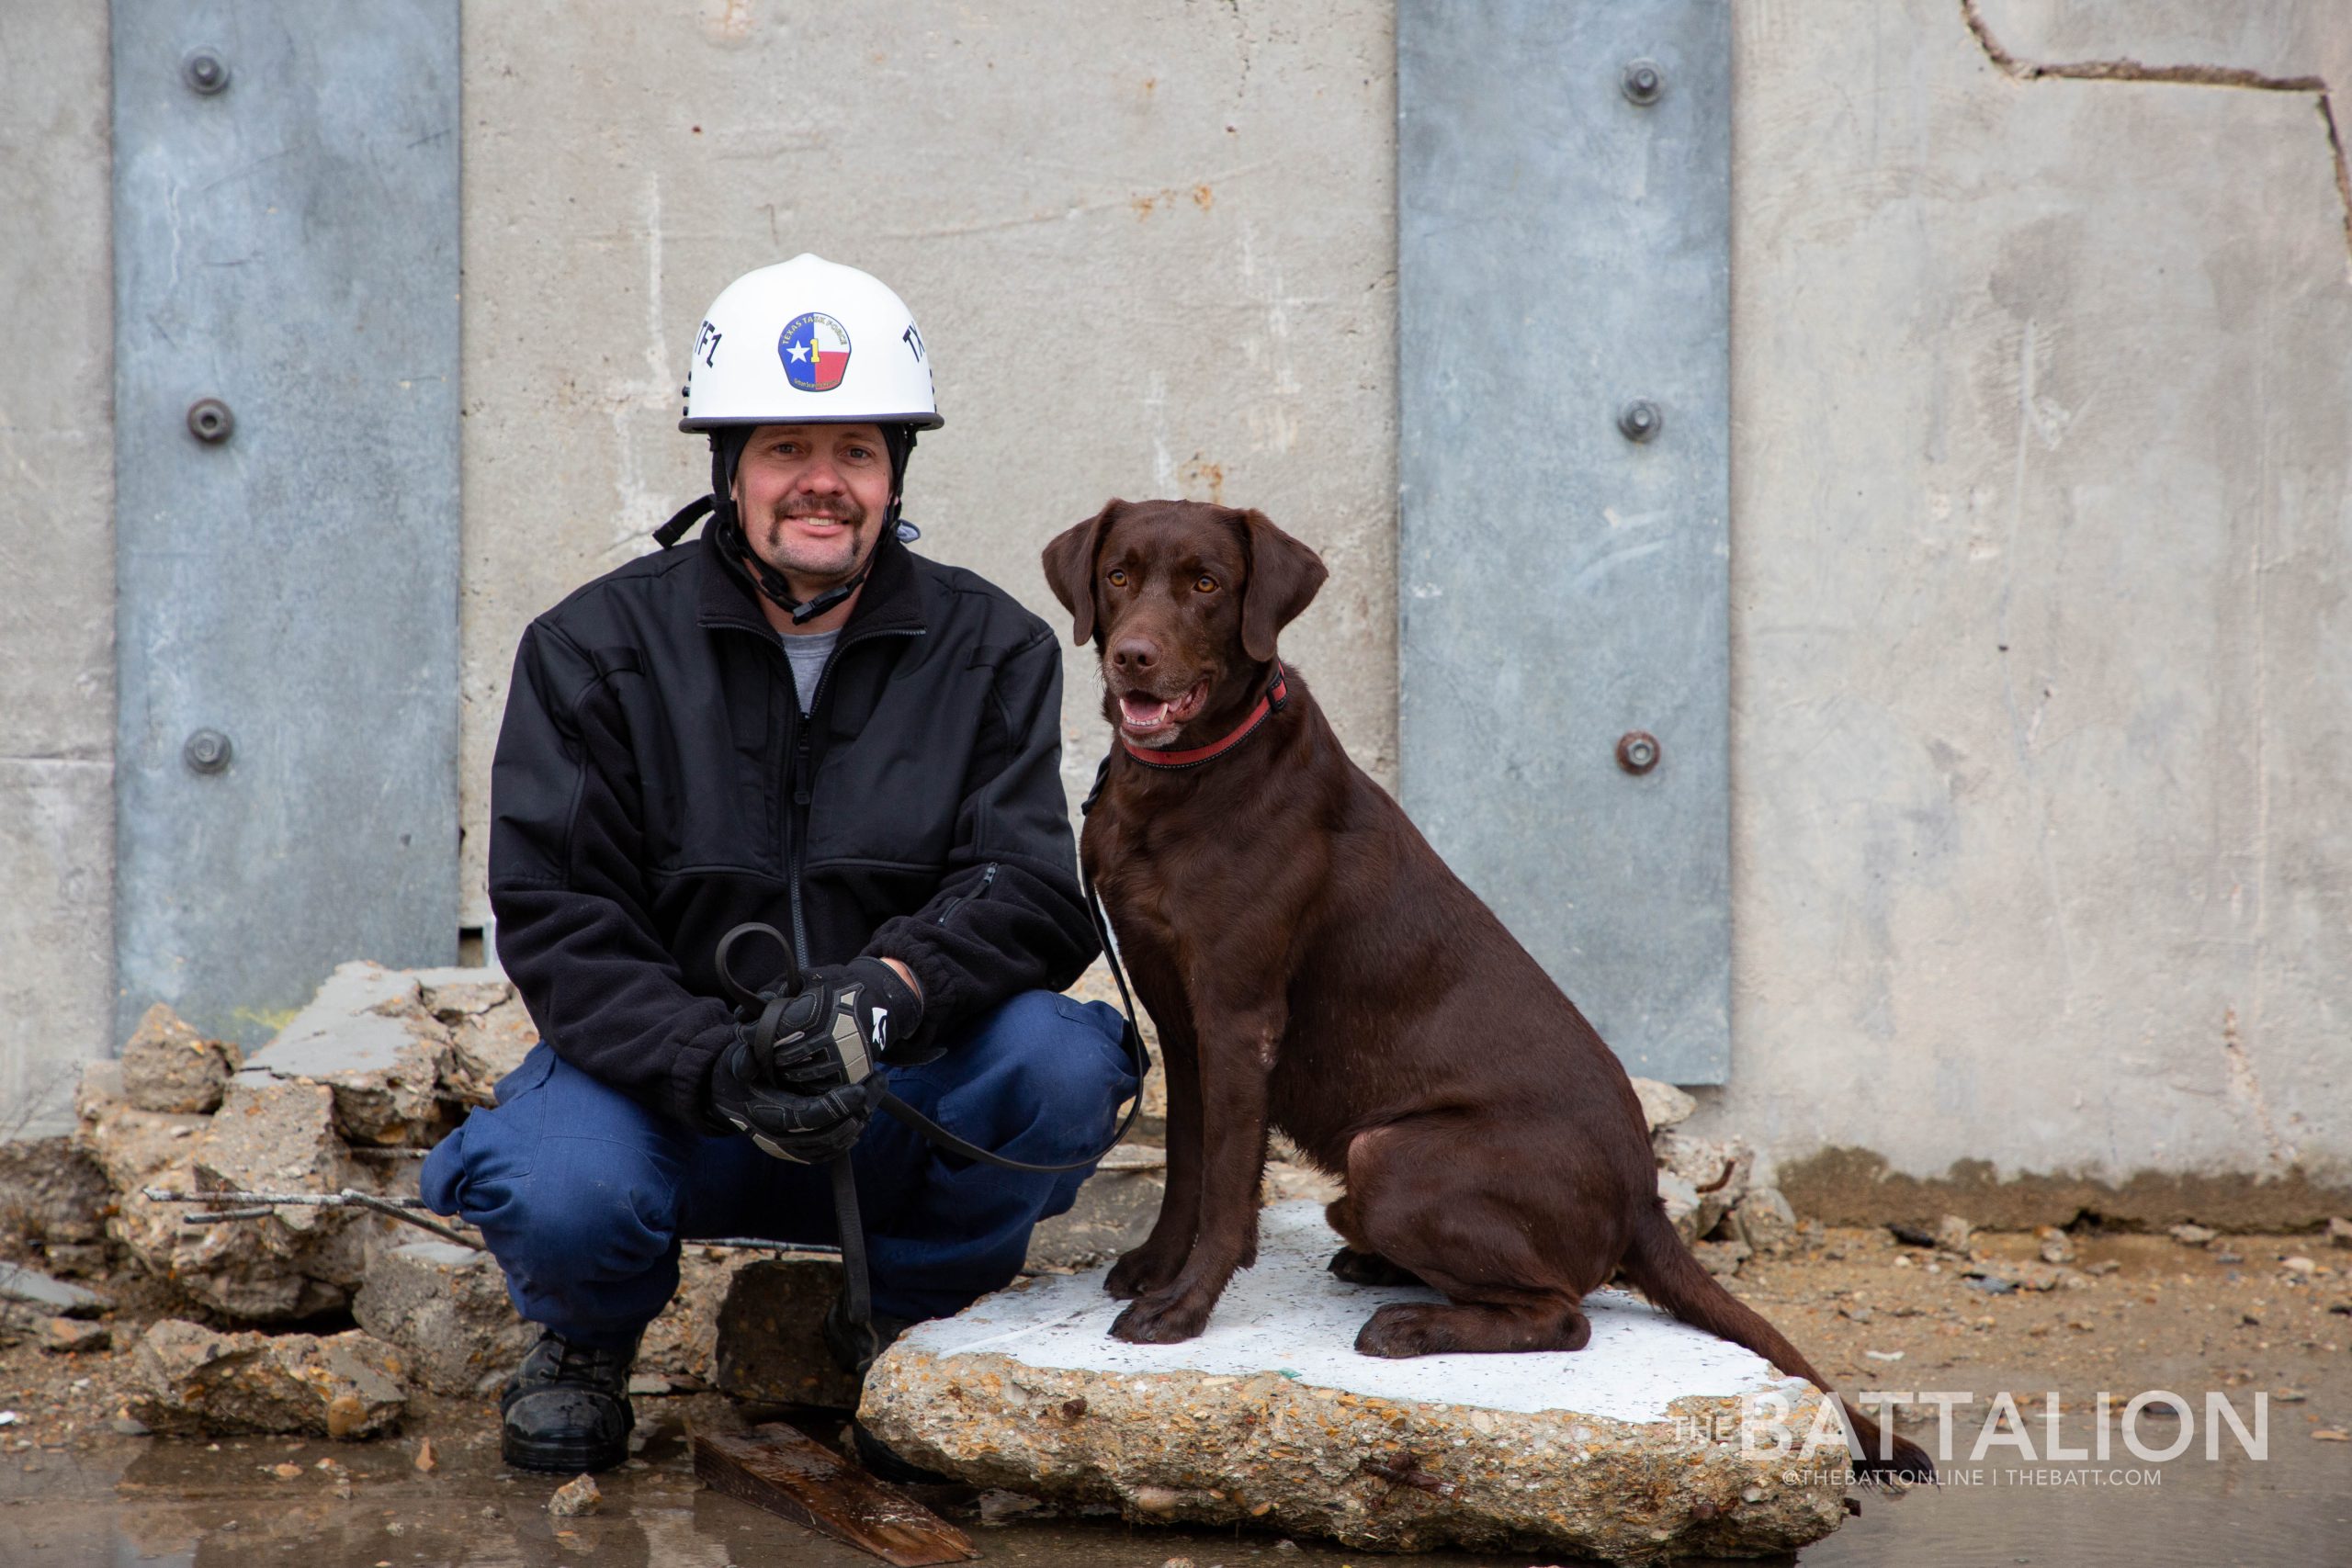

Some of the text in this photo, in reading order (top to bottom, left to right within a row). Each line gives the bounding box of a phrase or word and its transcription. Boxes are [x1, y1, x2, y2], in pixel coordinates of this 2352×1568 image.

[782, 316, 848, 345] TEXAS TASK FORCE
[809, 338, 820, 363] 1
